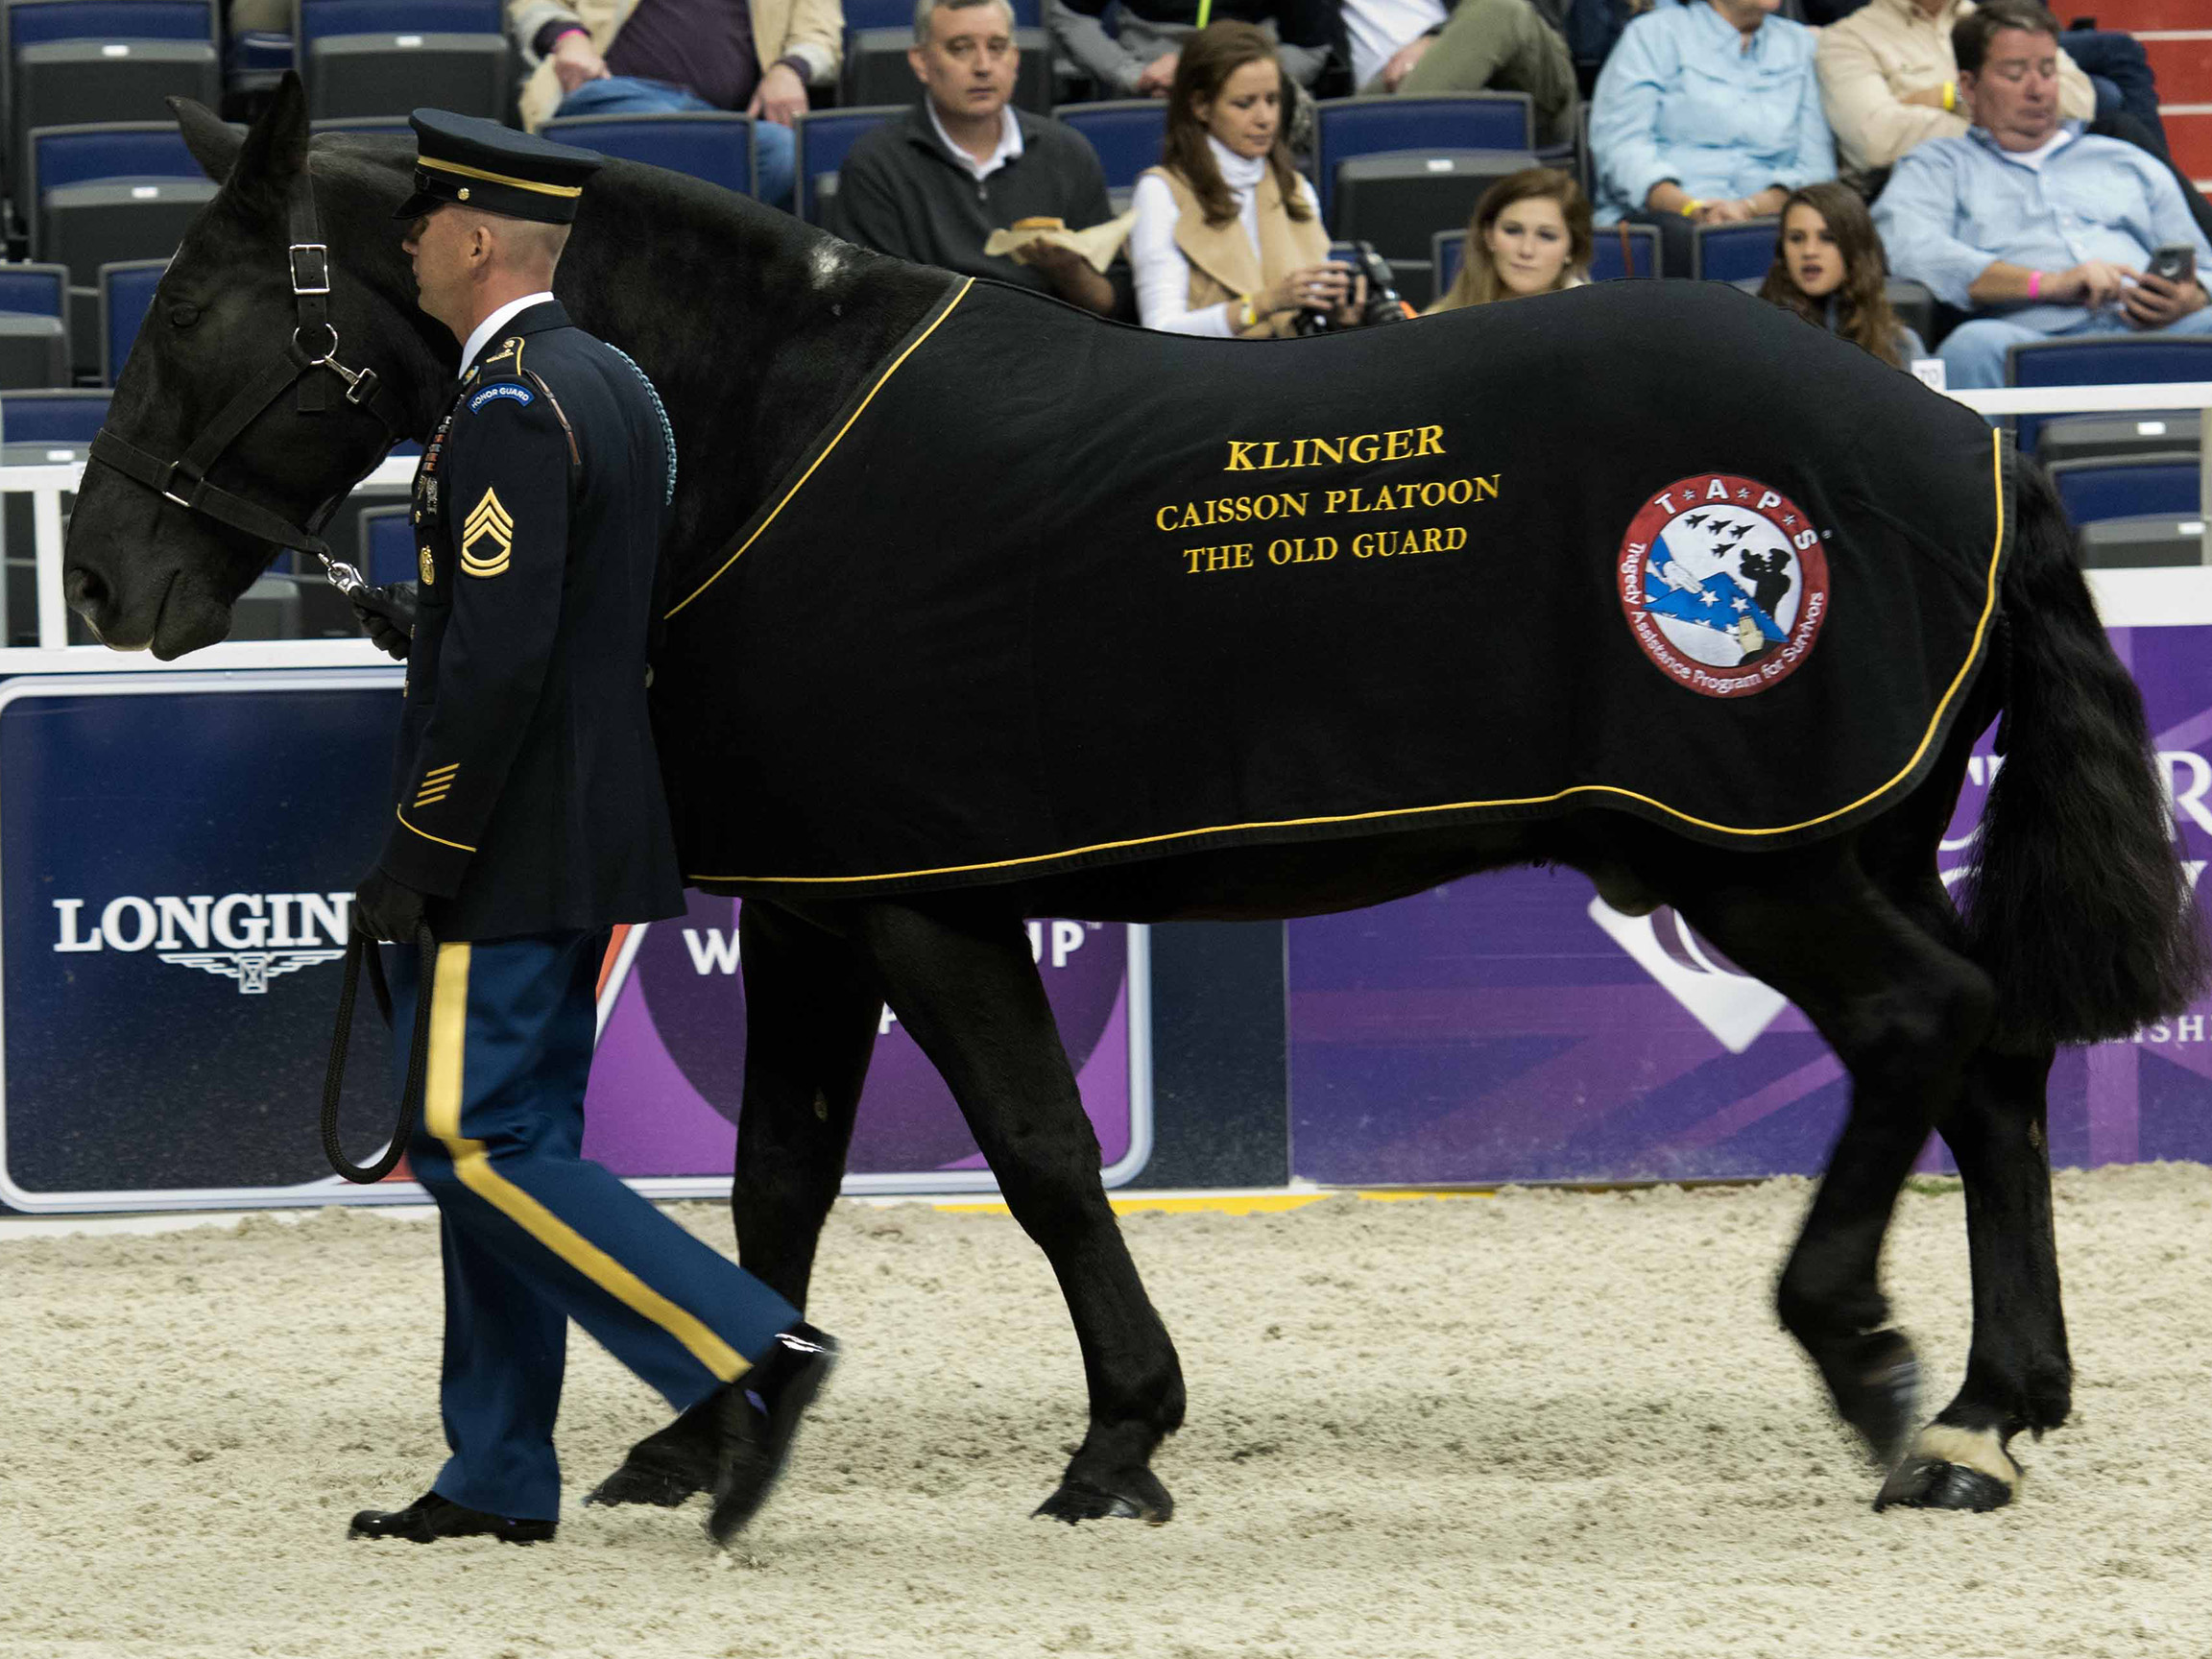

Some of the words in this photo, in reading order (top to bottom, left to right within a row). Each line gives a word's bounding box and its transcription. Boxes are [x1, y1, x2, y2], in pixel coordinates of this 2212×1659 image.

[471, 388, 498, 409] HONOR
[499, 387, 529, 401] GUARD
[1223, 424, 1447, 471] KLINGER
[1156, 493, 1310, 531] CAISSON
[1324, 474, 1502, 514] PLATOON
[1182, 543, 1255, 574] THE
[1267, 536, 1338, 565] OLD
[1352, 527, 1468, 559] GUARD
[1620, 542, 1647, 605] Tragedy
[1630, 611, 1692, 679] Assistance
[1781, 591, 1824, 662] Survivors
[1693, 669, 1764, 693] Program
[1761, 659, 1786, 679] for
[53, 892, 396, 952] LONGIN
